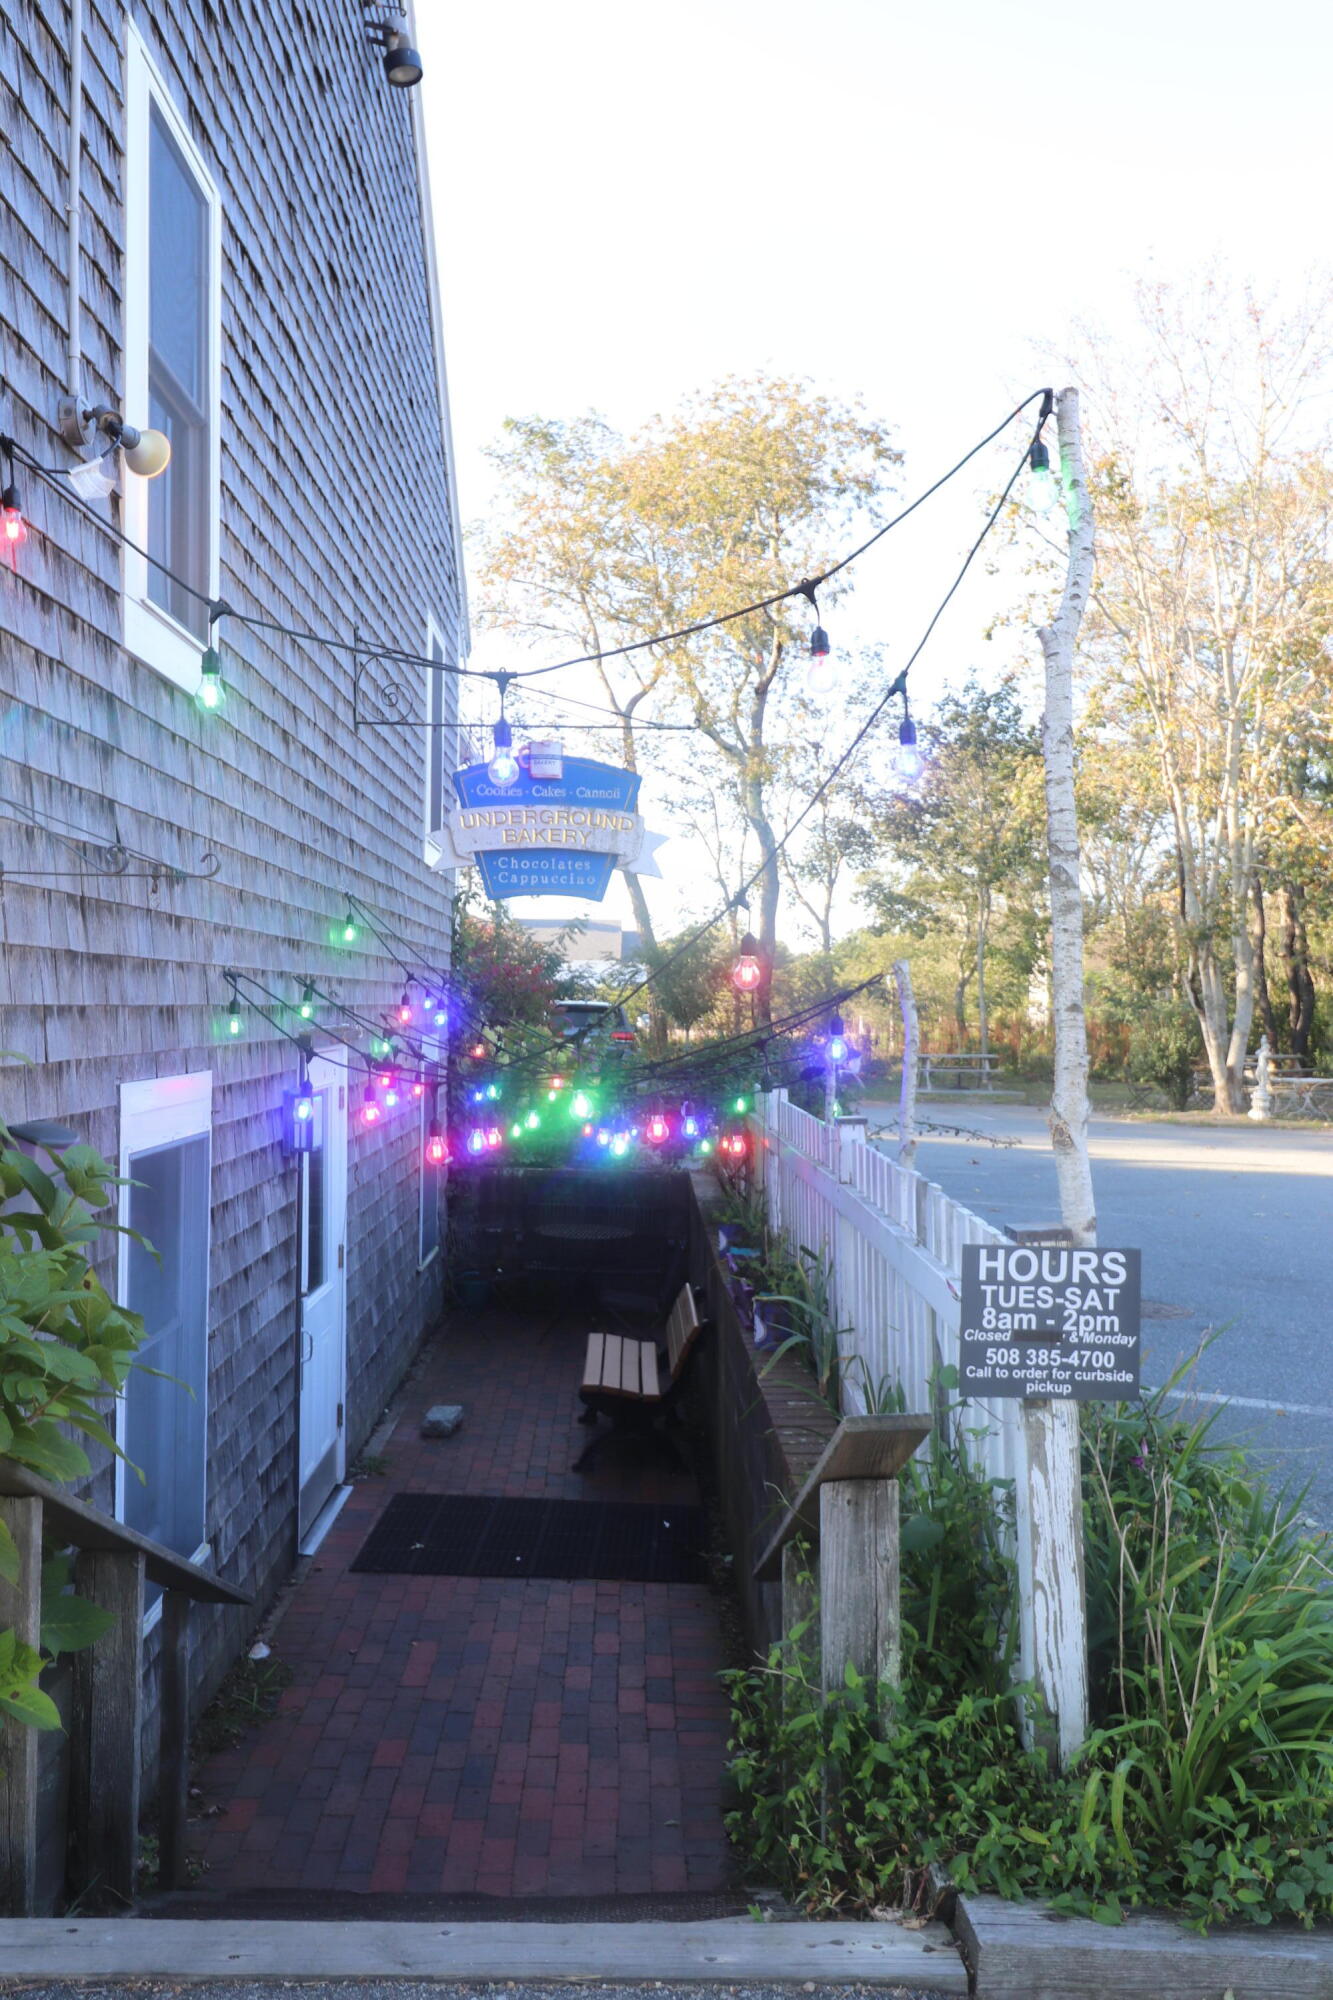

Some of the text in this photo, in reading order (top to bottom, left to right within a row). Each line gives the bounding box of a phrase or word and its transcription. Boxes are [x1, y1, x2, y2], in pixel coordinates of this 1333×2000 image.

[532, 785, 566, 798] Cakes
[459, 810, 634, 831] UNDERGROUND
[502, 828, 592, 844] BAKERY
[978, 1248, 1128, 1286] HOURS
[980, 1285, 1121, 1311] TUES-SAT
[982, 1307, 1037, 1330] 8am
[1062, 1309, 1120, 1337] 2pm
[964, 1329, 1012, 1342] Closed
[1069, 1332, 1079, 1343] &
[1082, 1333, 1137, 1348] Monday
[986, 1349, 1116, 1369] 508 385-4700
[966, 1366, 1134, 1383] Call to order for curbside
[1026, 1381, 1072, 1395] pickup
